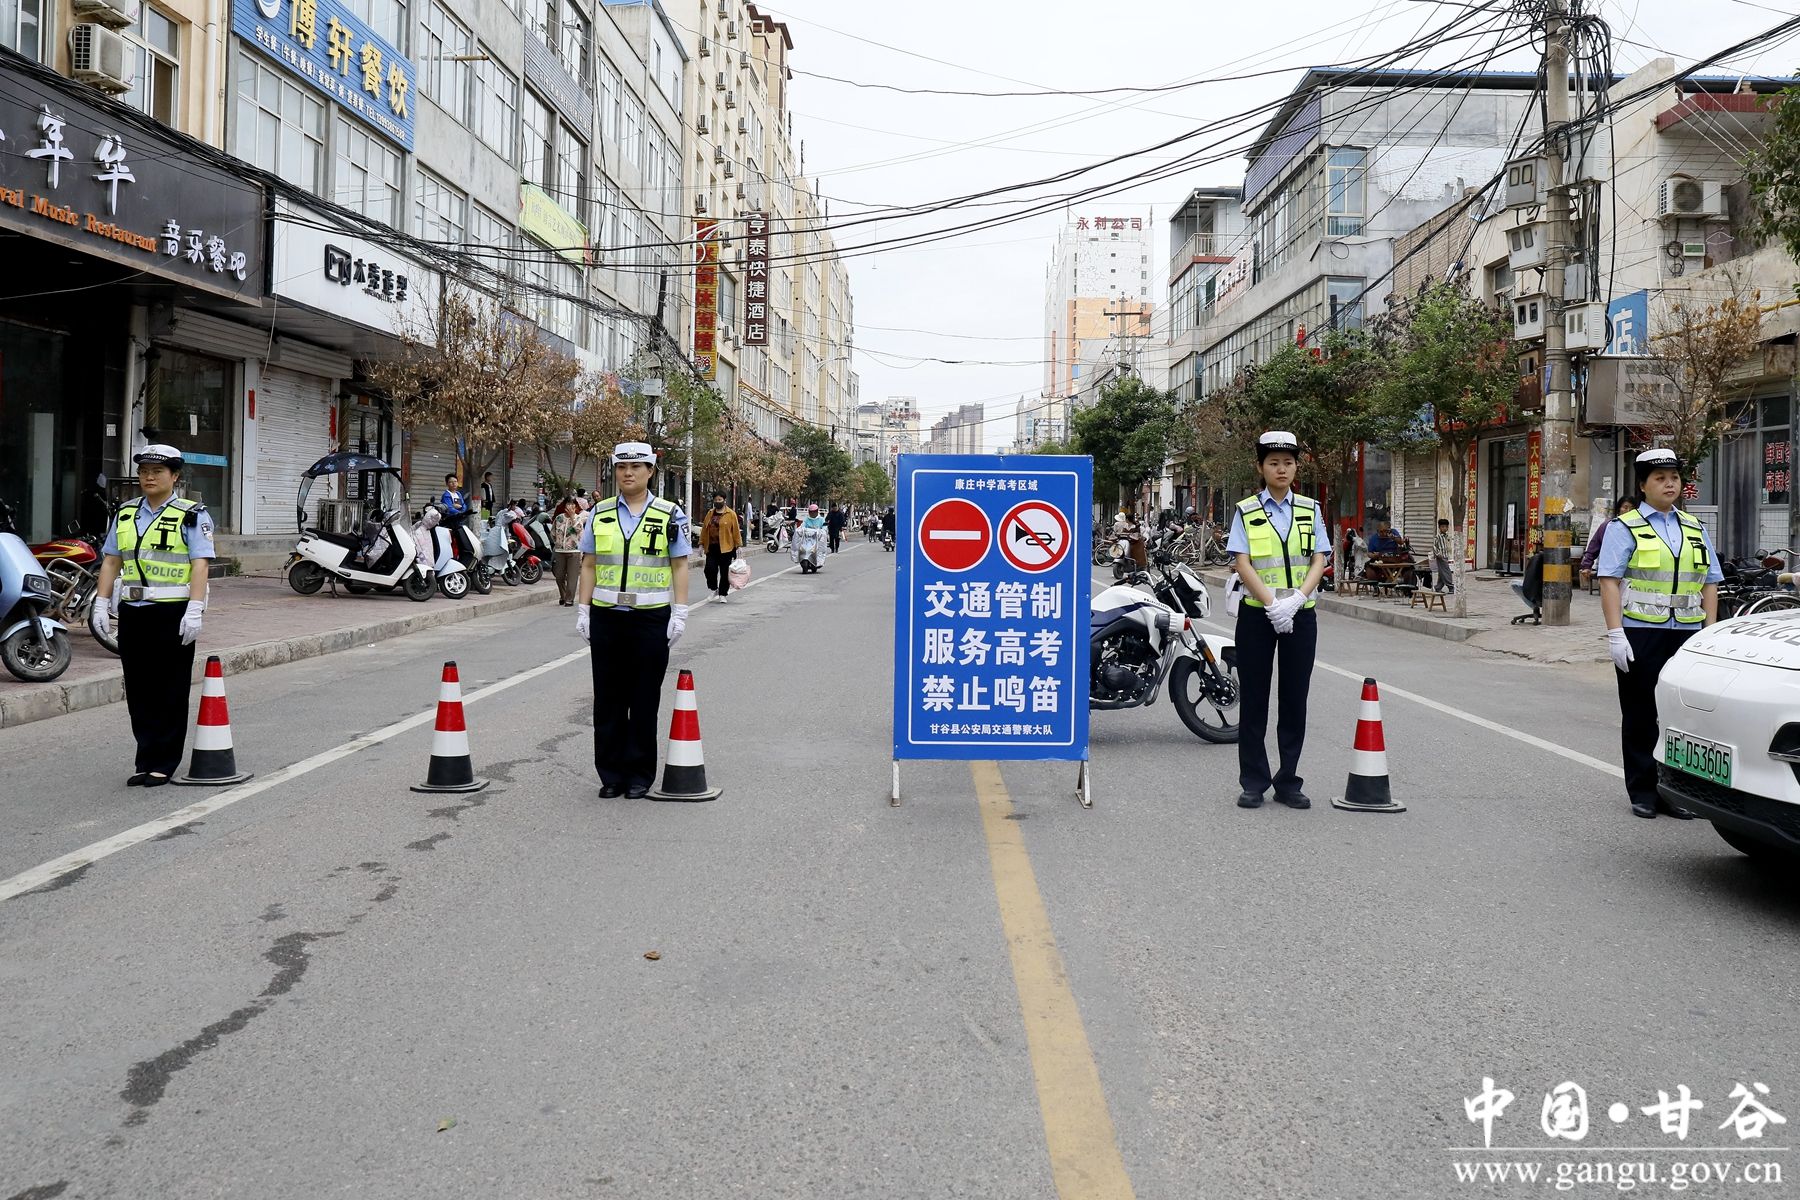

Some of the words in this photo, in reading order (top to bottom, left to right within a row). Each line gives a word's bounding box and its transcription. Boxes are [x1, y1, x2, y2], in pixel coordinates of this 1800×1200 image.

[0, 104, 136, 216] 年华
[30, 195, 79, 225] Music
[84, 213, 157, 253] Restaurant
[1077, 216, 1142, 231] 永利公司
[161, 219, 246, 281] 音乐餐吧
[955, 478, 1038, 491] 康庄中学高考区域
[146, 565, 184, 577] POLICE
[634, 572, 664, 583] POLICE
[923, 581, 1062, 619] 交通管制
[922, 628, 1063, 666] 服务高考
[921, 675, 1061, 713] 禁止鸣笛
[929, 723, 1053, 736] 甘谷县公安局交通警察大队
